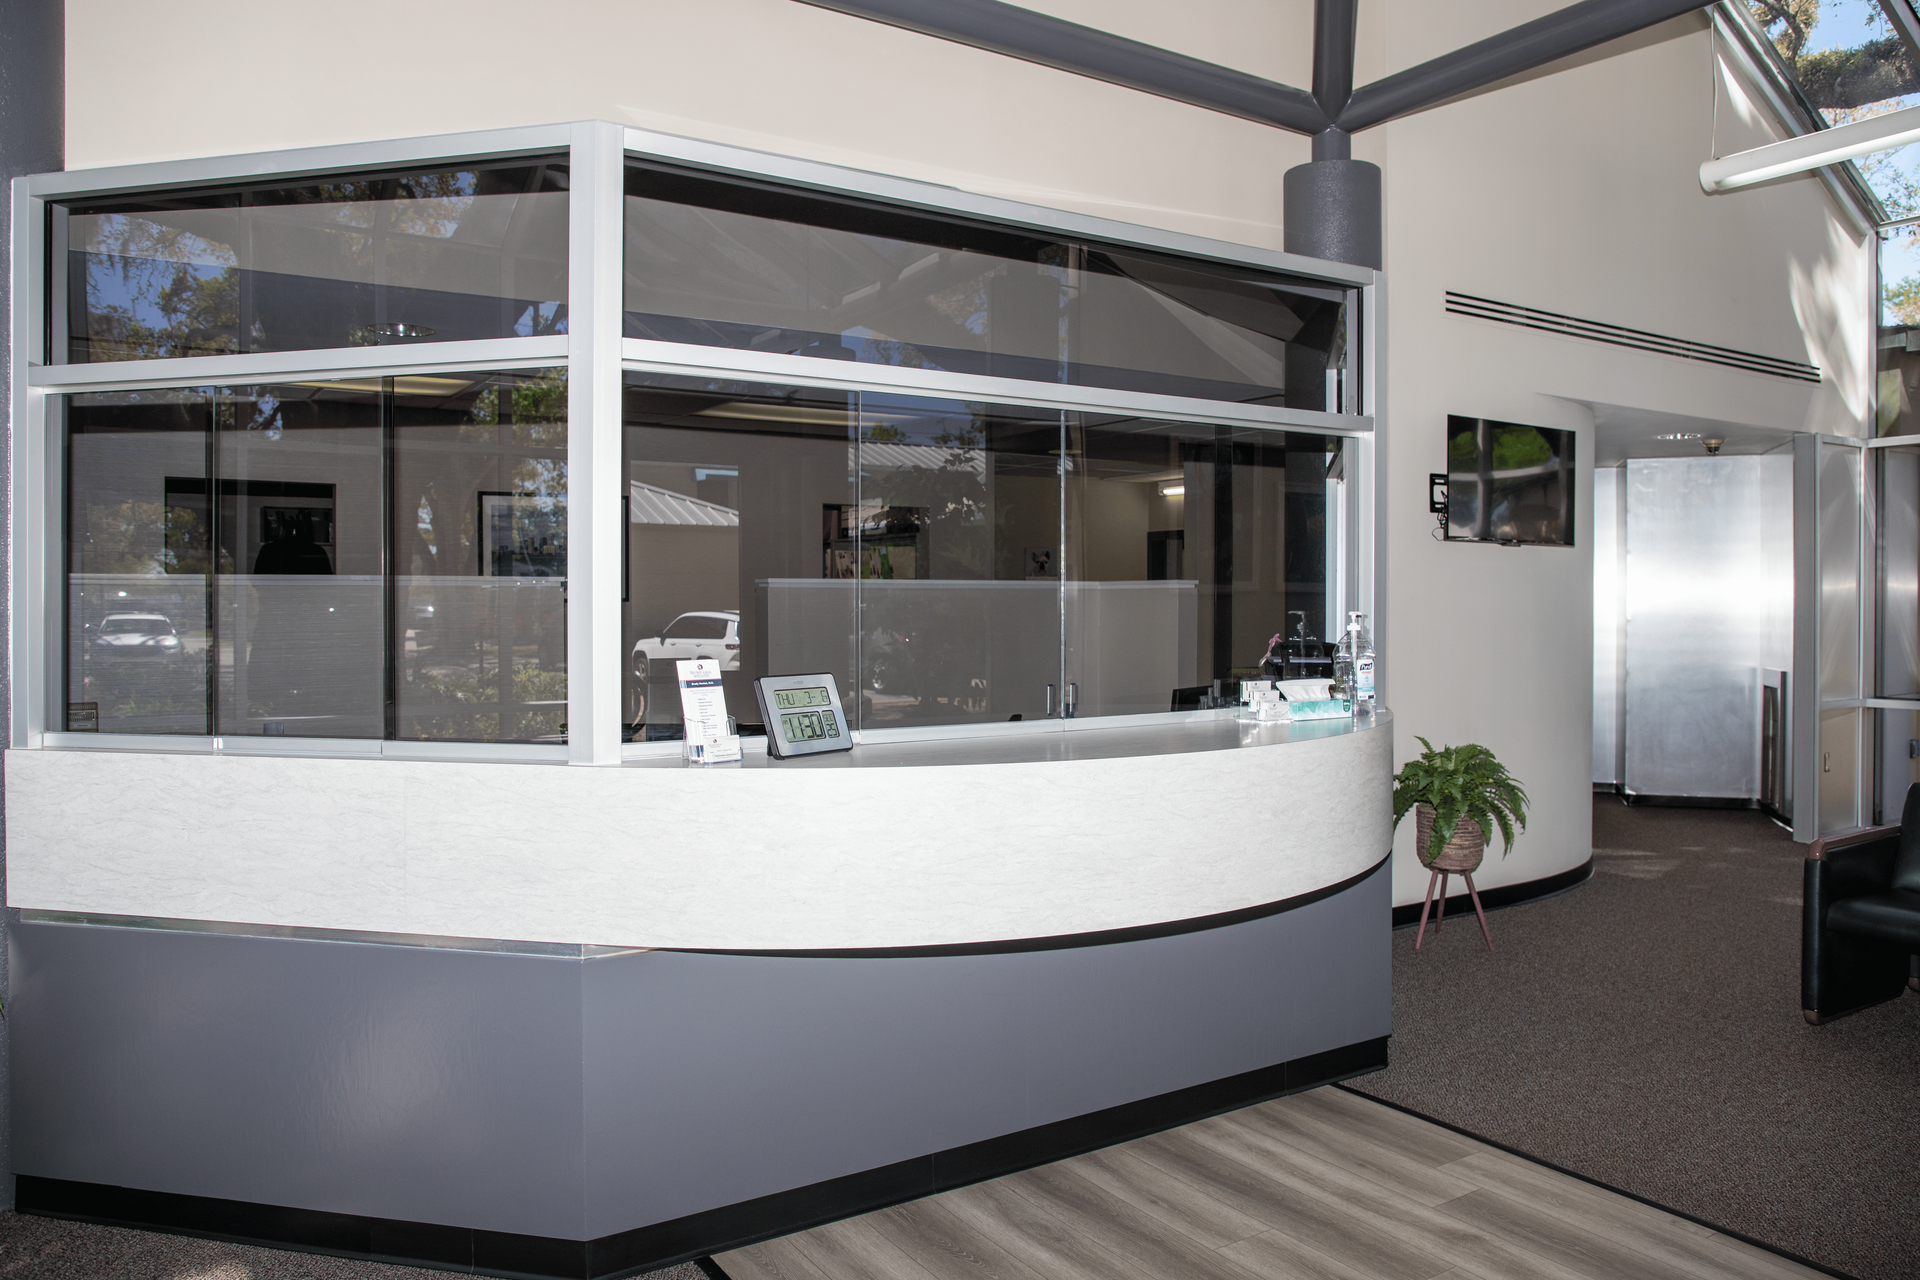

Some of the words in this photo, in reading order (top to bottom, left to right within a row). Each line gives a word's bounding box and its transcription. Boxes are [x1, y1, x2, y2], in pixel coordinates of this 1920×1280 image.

[776, 693, 795, 706] THU
[789, 713, 824, 740] 11:30
[826, 723, 838, 736] 25
